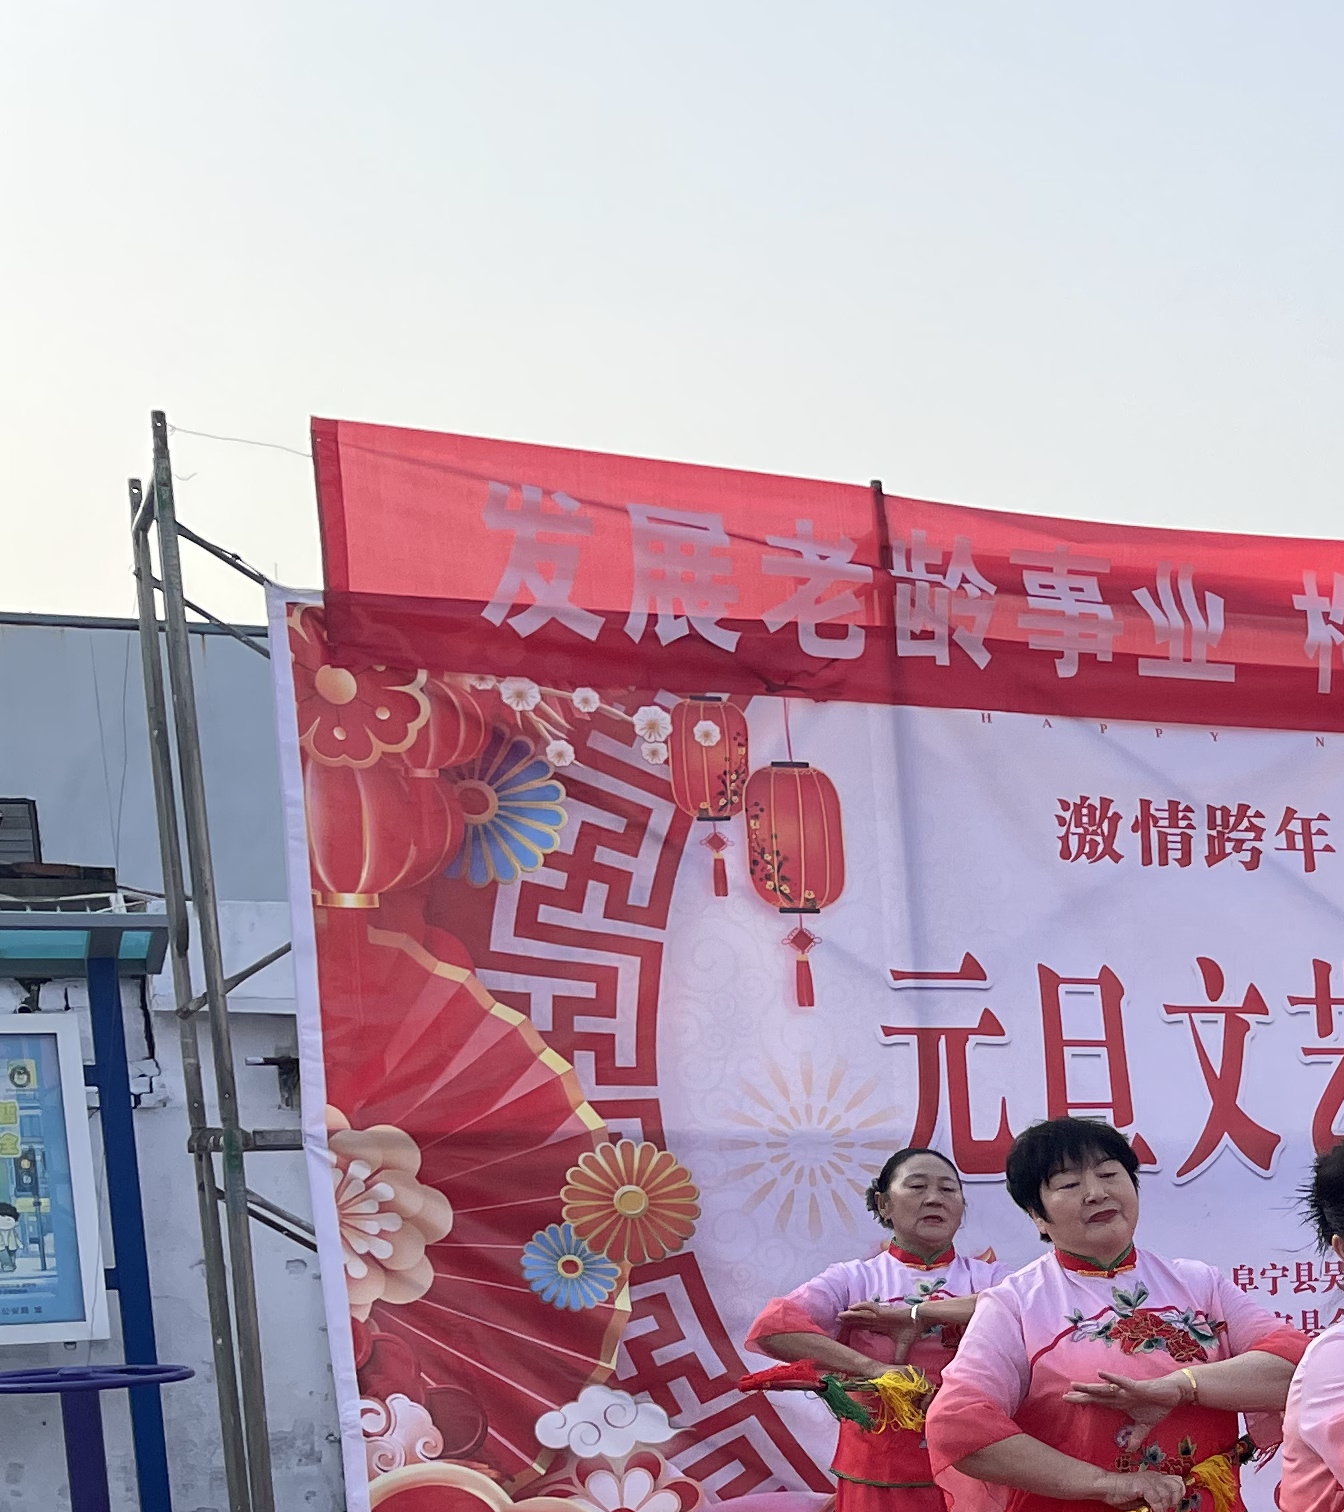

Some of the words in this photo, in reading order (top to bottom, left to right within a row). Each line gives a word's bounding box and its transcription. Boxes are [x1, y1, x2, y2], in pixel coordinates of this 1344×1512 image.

[481, 479, 1238, 684] 发展老龄事业
[1054, 794, 1337, 874] 激情跨年
